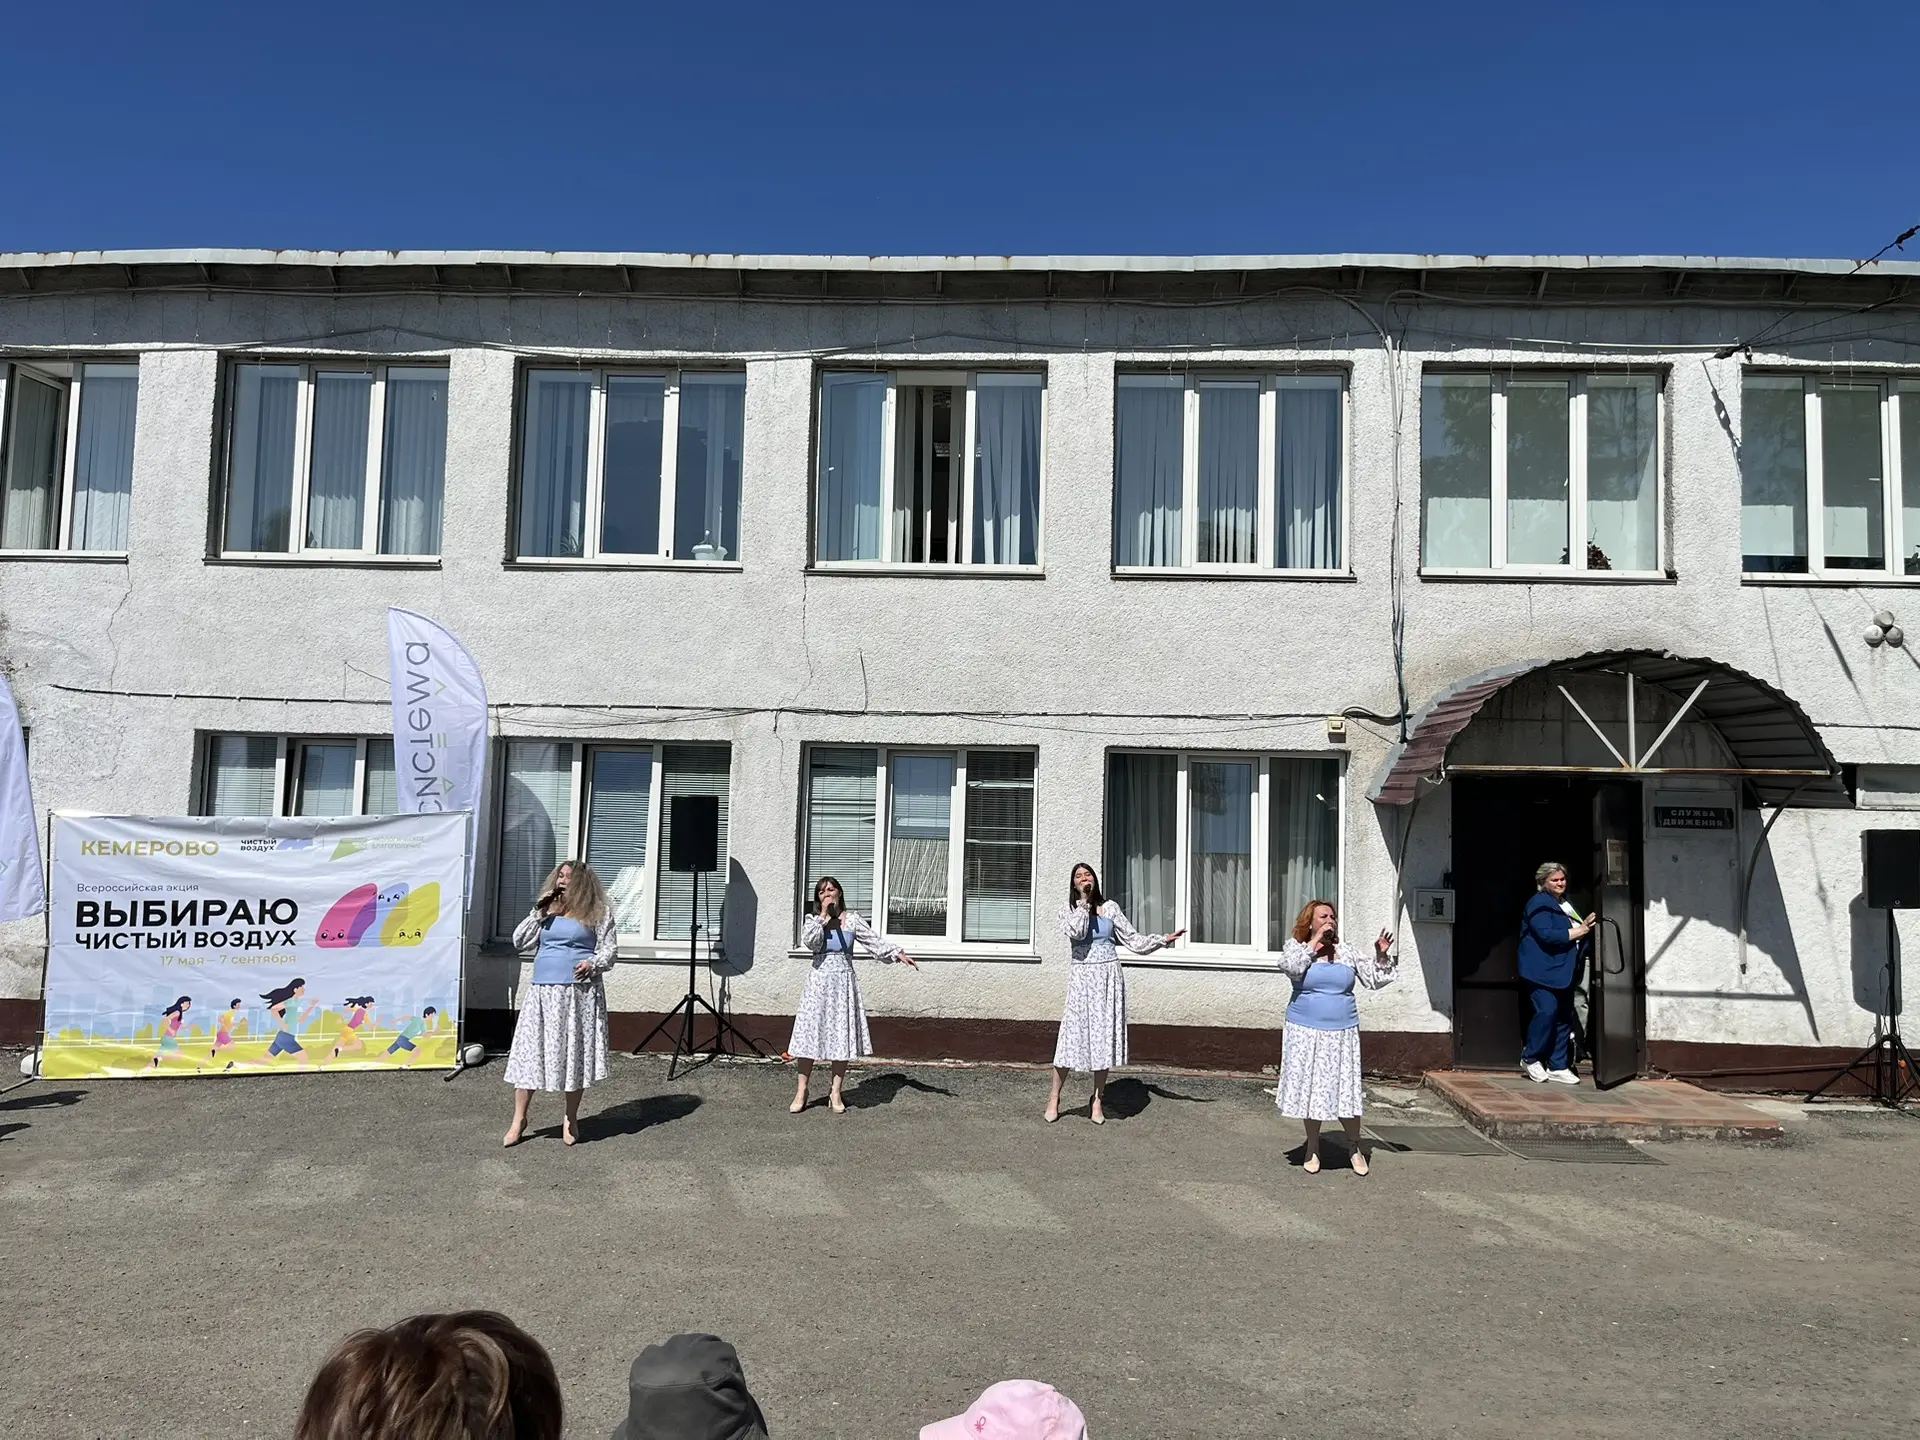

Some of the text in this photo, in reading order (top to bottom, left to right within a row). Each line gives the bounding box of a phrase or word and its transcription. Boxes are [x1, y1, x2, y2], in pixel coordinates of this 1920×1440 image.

[1670, 809, 1716, 817] СЛУЖБА
[1662, 818, 1723, 827] ДВИЖЕНИЯ
[81, 840, 220, 856] КЕМЕРОВО
[77, 883, 199, 894] Всероссийская акция
[75, 898, 299, 927] ВЫБИРАЮ
[75, 929, 297, 950] ЧИСТЫЙ ВОЗДУХ
[160, 955, 174, 966] 17
[178, 956, 204, 966] мая
[219, 954, 228, 965] 7
[230, 953, 297, 967] сентября
